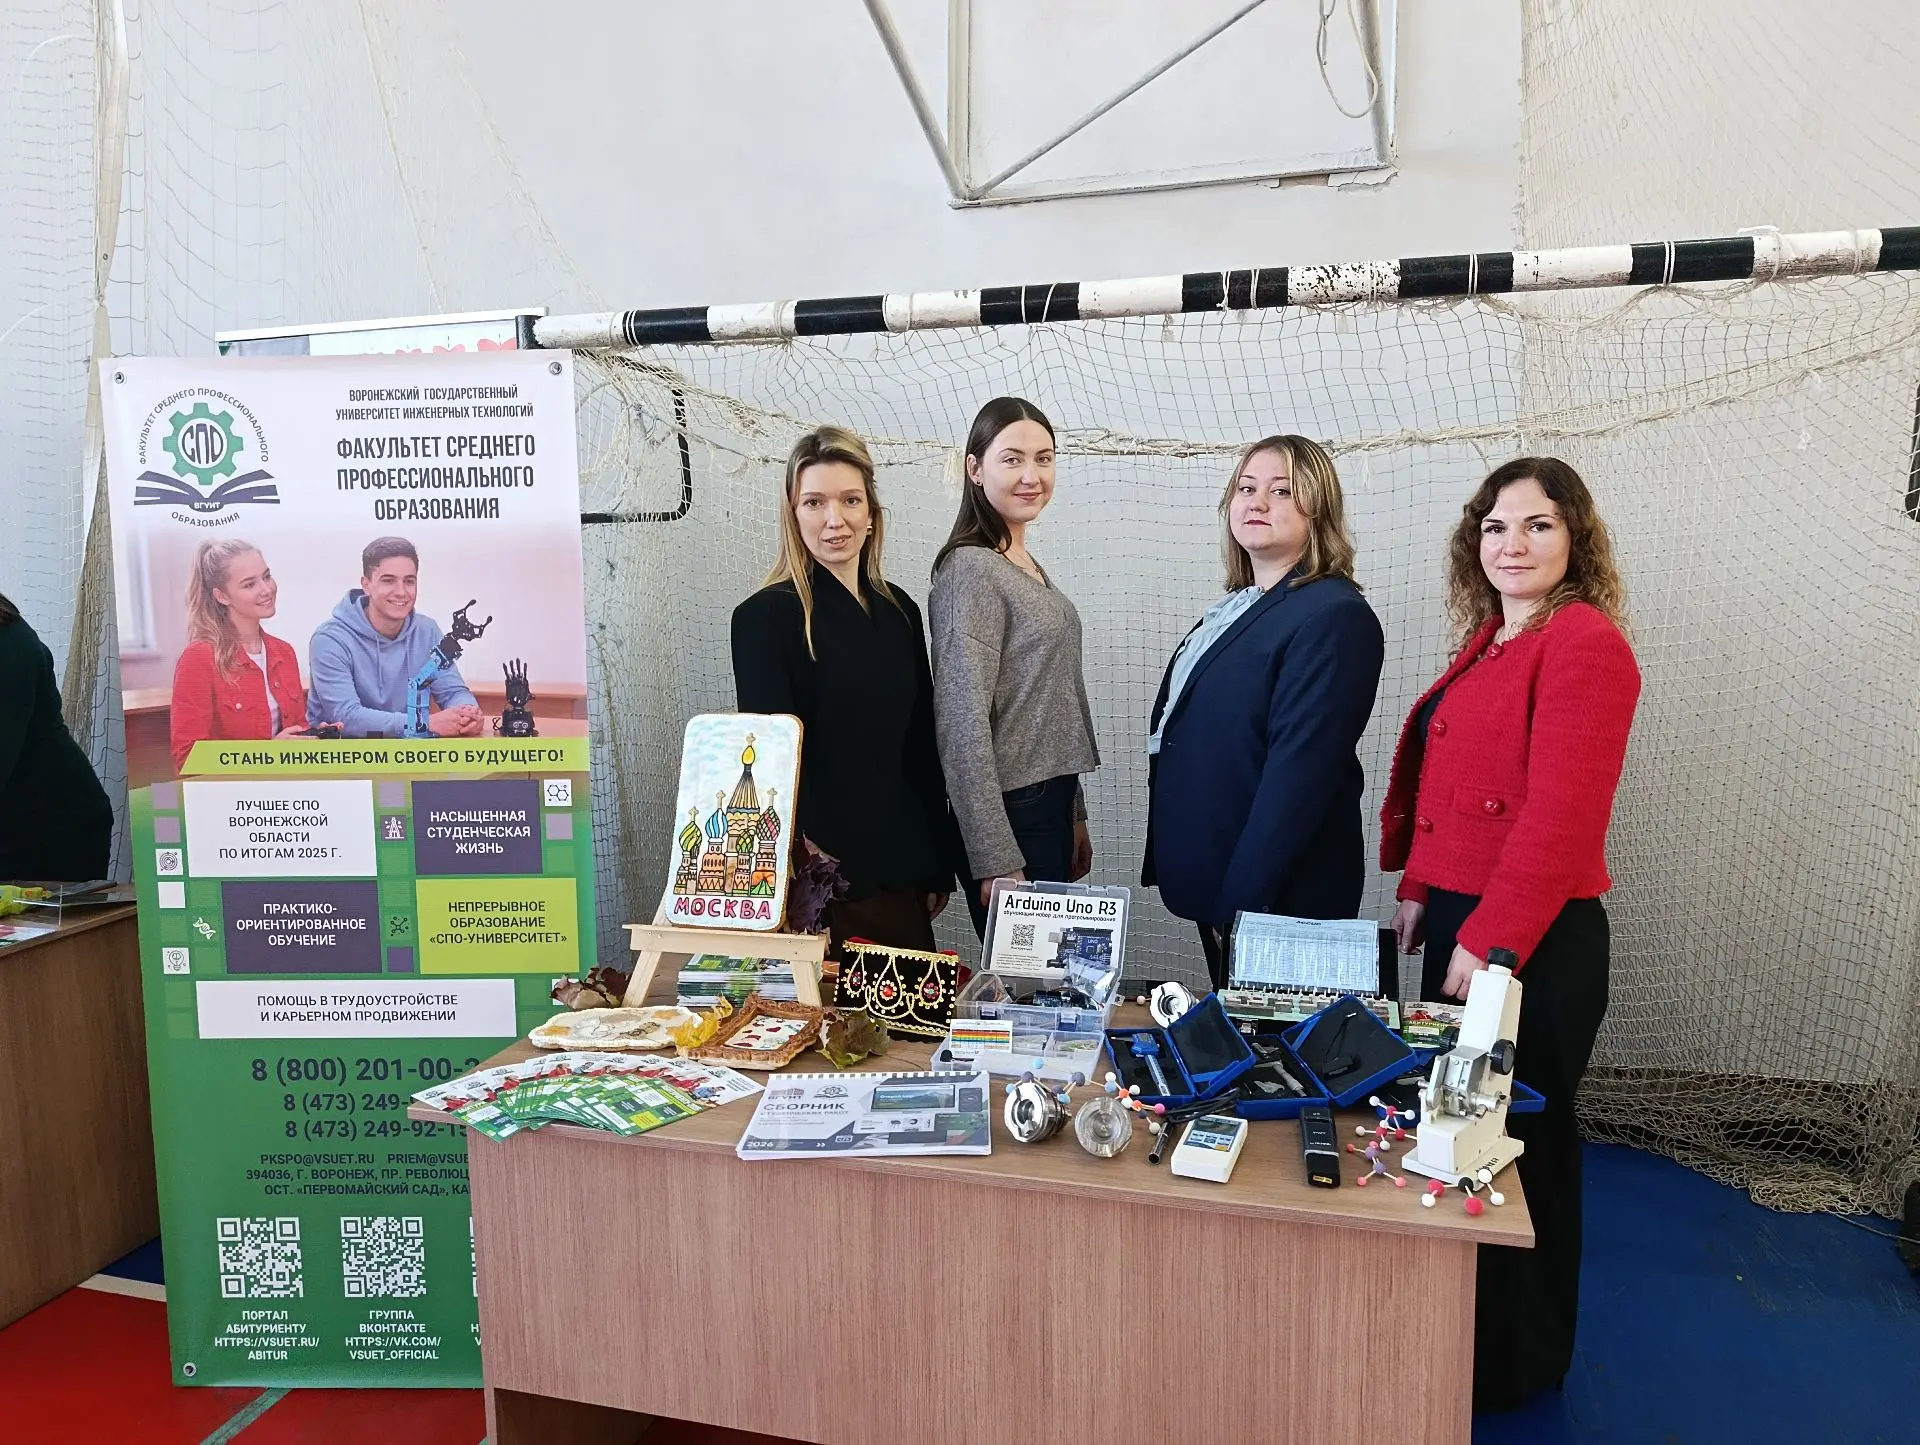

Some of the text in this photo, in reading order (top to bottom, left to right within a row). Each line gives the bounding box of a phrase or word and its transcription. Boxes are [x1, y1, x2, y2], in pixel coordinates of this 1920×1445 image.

[349, 384, 518, 402] ВОРОНЕЖСКИЙ ГОСУДАРСТВЕННЫЙ
[335, 402, 534, 421] УНИВЕРСИТЕТ ИНЖЕНЕРНЫХ ТЕХНОЛОГИЙ
[139, 388, 268, 464] ФАКУЛЬТЕТ СРЕДНЕГО ПРОФЕССИОНАЛЬНОГО
[182, 423, 223, 464] СПО
[337, 434, 536, 460] ФАКУЛЬТЕТ СРЕДНЕГО
[337, 465, 534, 490] ПРОФЕССИОНАЛЬНОГО
[193, 502, 221, 510] ВГУИТ
[374, 497, 500, 521] ОБРАЗОВАНИЯ
[172, 511, 240, 527] ОБРАЗОВАНИЯ
[219, 749, 564, 765] СТАНЬ ИНЖЕНЕРОМ СВОЕГО БУДУЩЕГО!
[235, 800, 320, 811] ЛУЧШЕЕ СПО
[229, 813, 328, 827] ВОРОНЕЖСКОЙ
[430, 810, 526, 824] НАСЫЩЕННАЯ
[249, 832, 310, 843] ОБЛАСТИ
[426, 826, 531, 840] СТУДЕНЧЕСКАЯ
[219, 847, 342, 859] ПО ИТОГАМ 2025 Г.
[455, 842, 504, 854] ЖИЗНЬ
[263, 903, 337, 915] ПРАКТИКО-
[448, 901, 545, 913] НЕПРЕРЫВНОЕ
[674, 897, 771, 920] МОСКВА
[1005, 895, 1116, 915] Arduino Uno R3
[236, 918, 367, 931] ОРИЕНТИРОВАННОЕ
[450, 916, 546, 928] ОБРАЗОВАНИЕ
[268, 934, 337, 946] ОБУЧЕНИЕ
[429, 932, 567, 945] «СПО-УНИВЕРСИТЕТ»
[257, 993, 458, 1008] ПОМОЩЬ В ТРУДОУСТРОЙСТВЕ
[260, 1010, 456, 1023] И КАРЬЕРНОМ ПРОДВИЖЕНИИ
[252, 1057, 480, 1087] 8 (800) 201-00-
[283, 1093, 412, 1115] 8 (473) 249-
[763, 1102, 845, 1111] СБОРНИК
[285, 1121, 298, 1137] 8
[304, 1119, 358, 1142] (473)
[261, 1153, 469, 1167] PKSPO@VSUET.RU PRIEM@VSUE
[246, 1168, 470, 1181] 394036, Г. ВОРОНЕЖ, ПР. РЕВОЛЮЦ
[264, 1182, 470, 1197] ОСТ. «ПЕРВОМАЙСКИЙ САД», КА
[242, 1311, 289, 1320] ПОРТАЛ
[369, 1310, 415, 1320] ГРУППА
[226, 1324, 307, 1333] АБИТУРИЕНТУ
[359, 1324, 426, 1333] ВКОНТАКТЕ
[214, 1337, 320, 1347] HTTPS://VSUET.RU/
[345, 1337, 441, 1346] HTTPS://VK.COM/
[248, 1351, 288, 1360] ABITUR
[349, 1350, 440, 1360] VSUET_OFFICIAL
